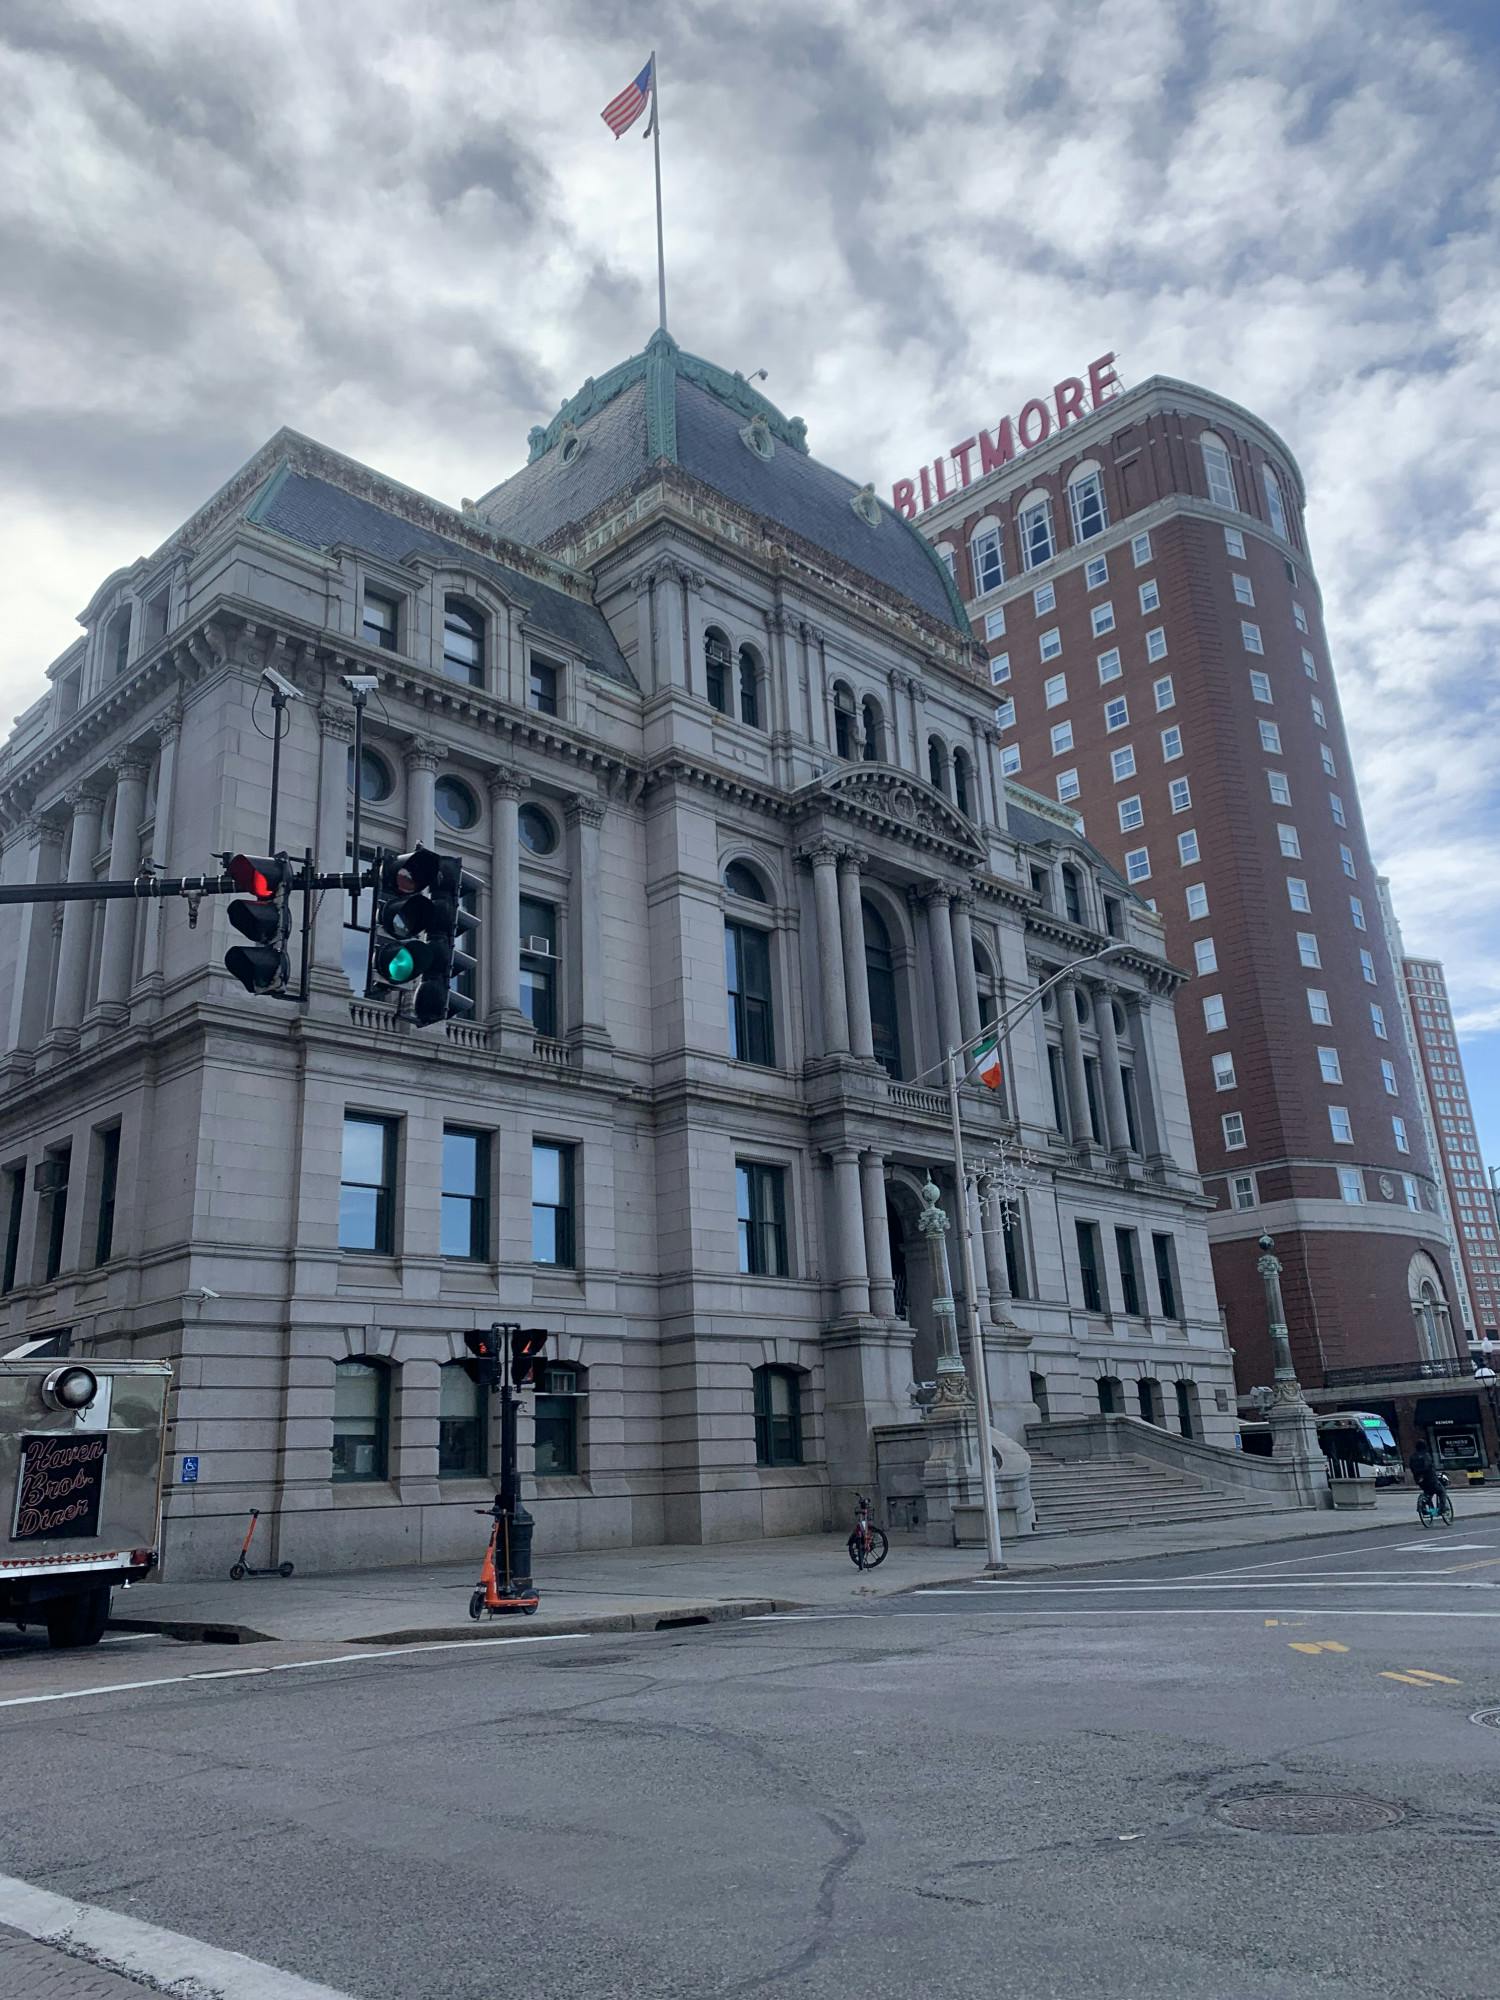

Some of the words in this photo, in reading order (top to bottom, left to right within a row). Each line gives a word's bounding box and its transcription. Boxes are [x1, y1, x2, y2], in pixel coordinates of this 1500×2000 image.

[892, 351, 1119, 520] BILTMORE
[25, 1438, 104, 1474] Haven
[21, 1468, 94, 1507] Bros.
[17, 1499, 89, 1536] Diner
